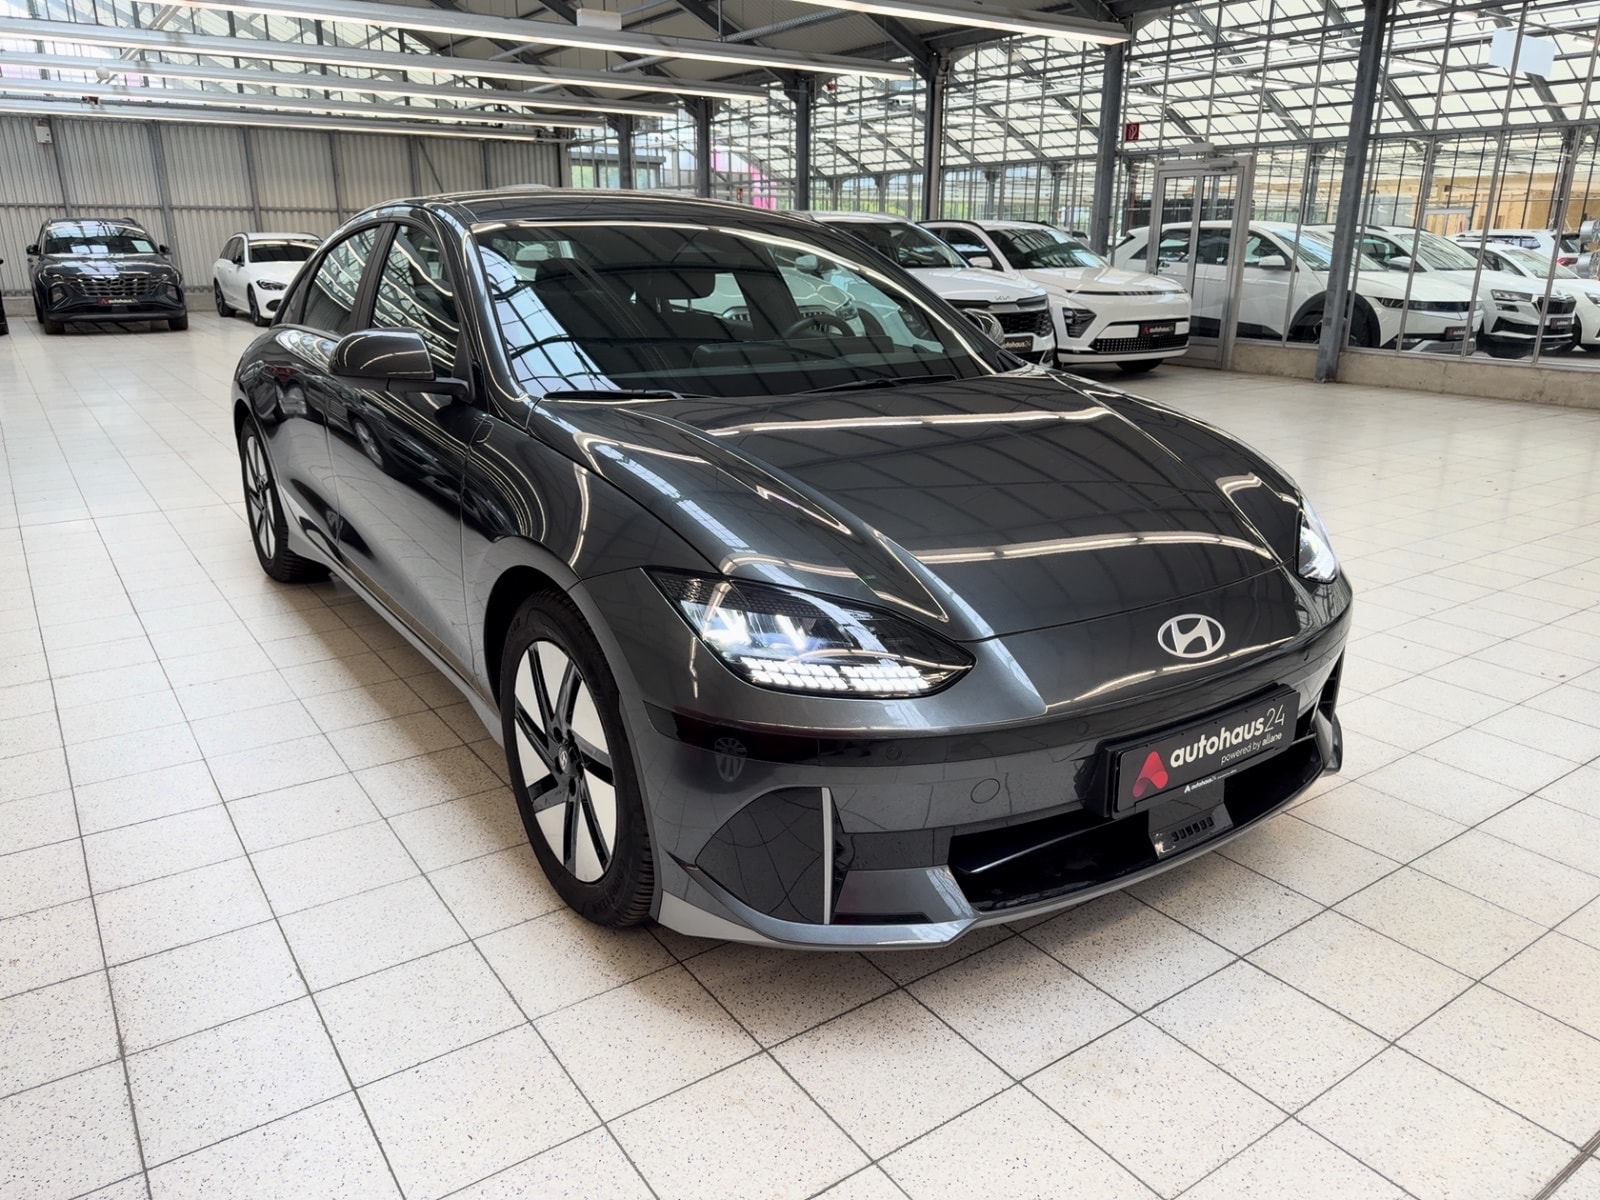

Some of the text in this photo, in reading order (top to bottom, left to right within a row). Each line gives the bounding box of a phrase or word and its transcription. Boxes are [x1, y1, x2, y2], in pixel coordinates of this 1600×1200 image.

[1170, 704, 1285, 767] autohaus24
[1220, 743, 1252, 765] powered
[1252, 738, 1262, 751] by
